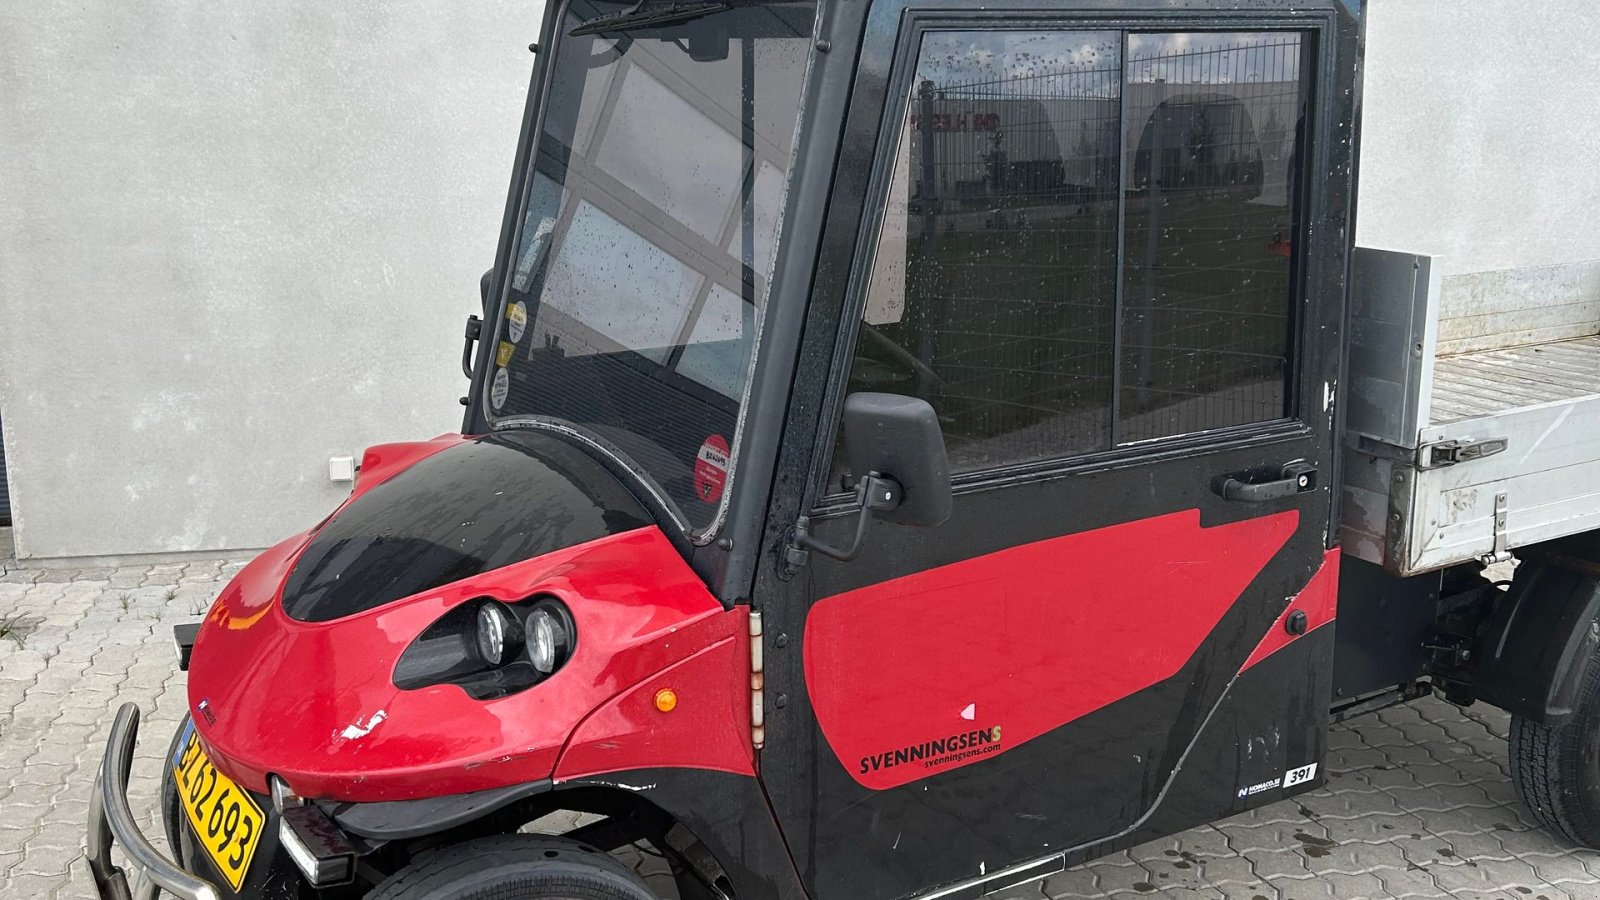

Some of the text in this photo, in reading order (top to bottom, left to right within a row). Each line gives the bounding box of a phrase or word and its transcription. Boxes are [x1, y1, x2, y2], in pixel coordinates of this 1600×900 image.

[860, 725, 1001, 774] SVENNINGSENS
[924, 743, 1001, 768] svenningsens.com
[1290, 766, 1312, 784] 391
[208, 788, 253, 870] 693
